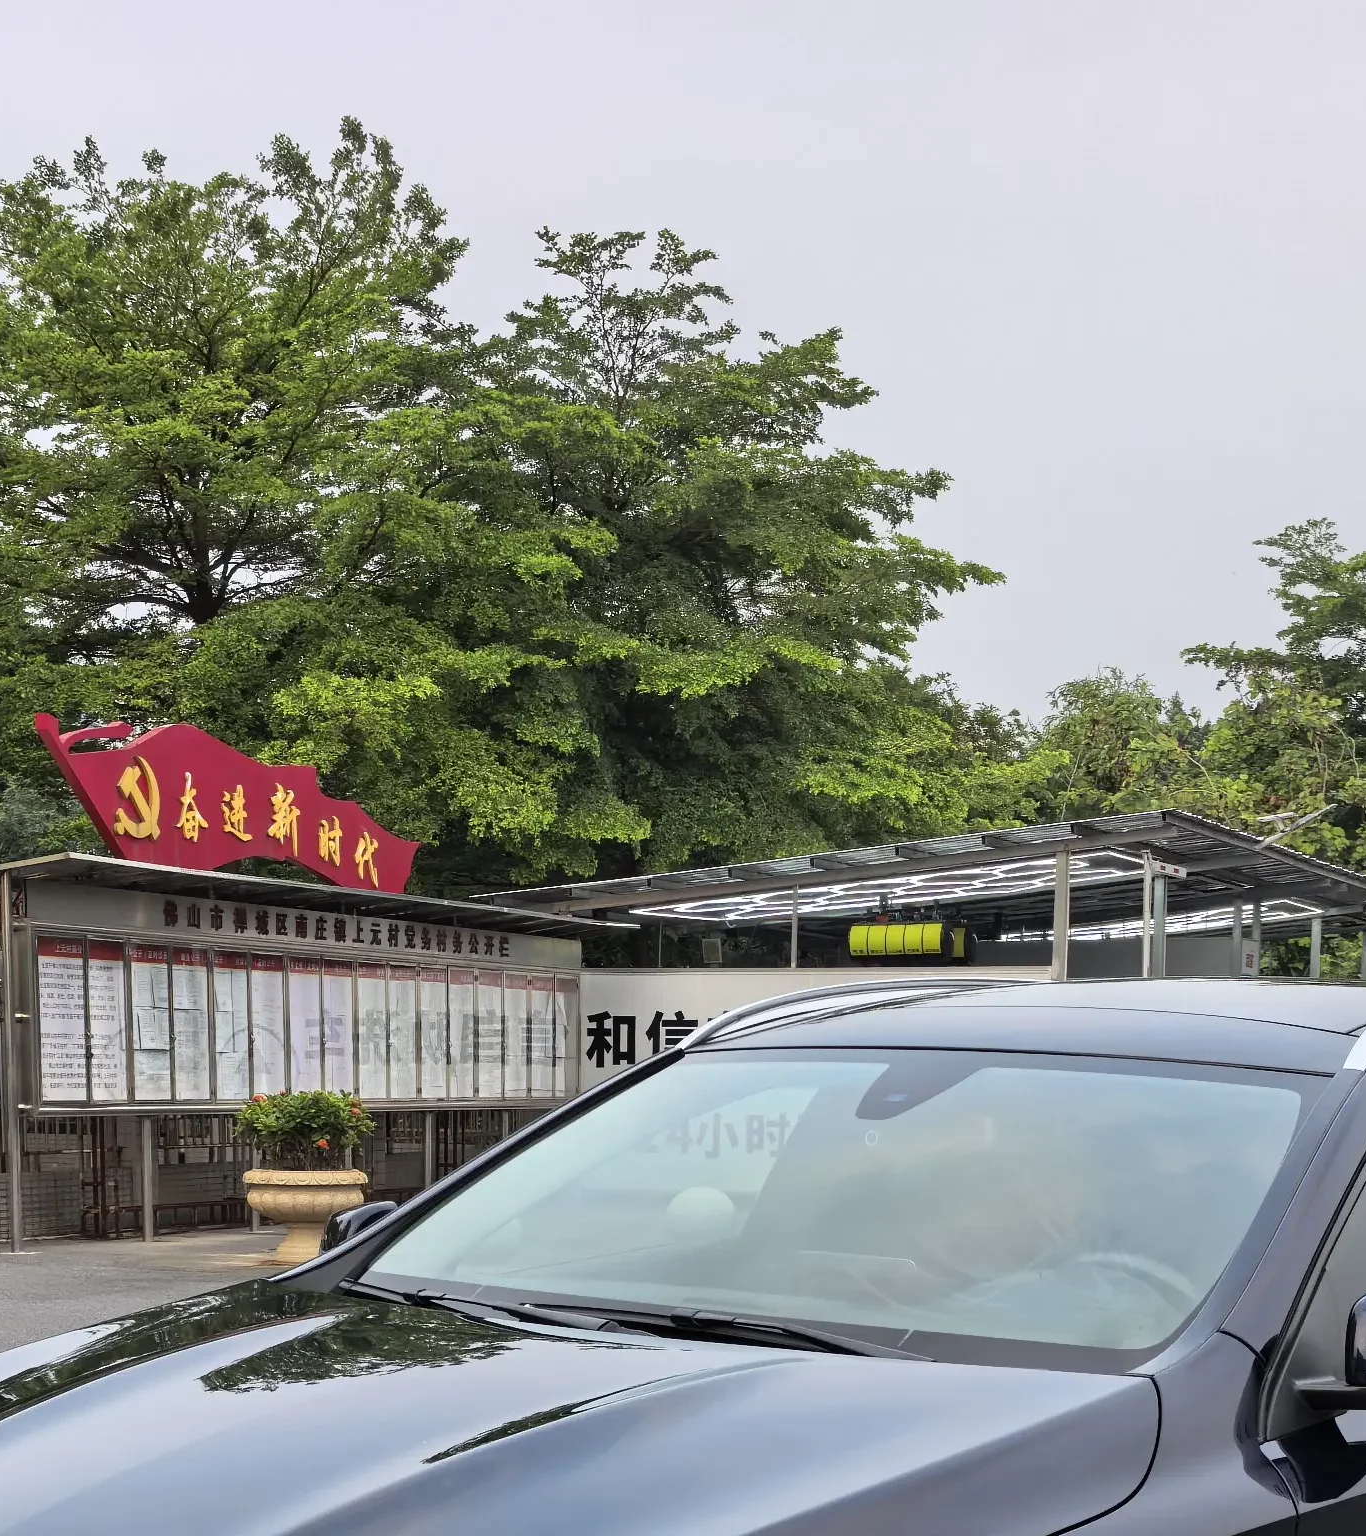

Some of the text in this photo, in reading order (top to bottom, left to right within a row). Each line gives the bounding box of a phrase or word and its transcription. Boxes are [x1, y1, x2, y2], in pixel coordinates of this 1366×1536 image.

[174, 772, 379, 888] 奋进新时代
[586, 1011, 728, 1068] 和信
